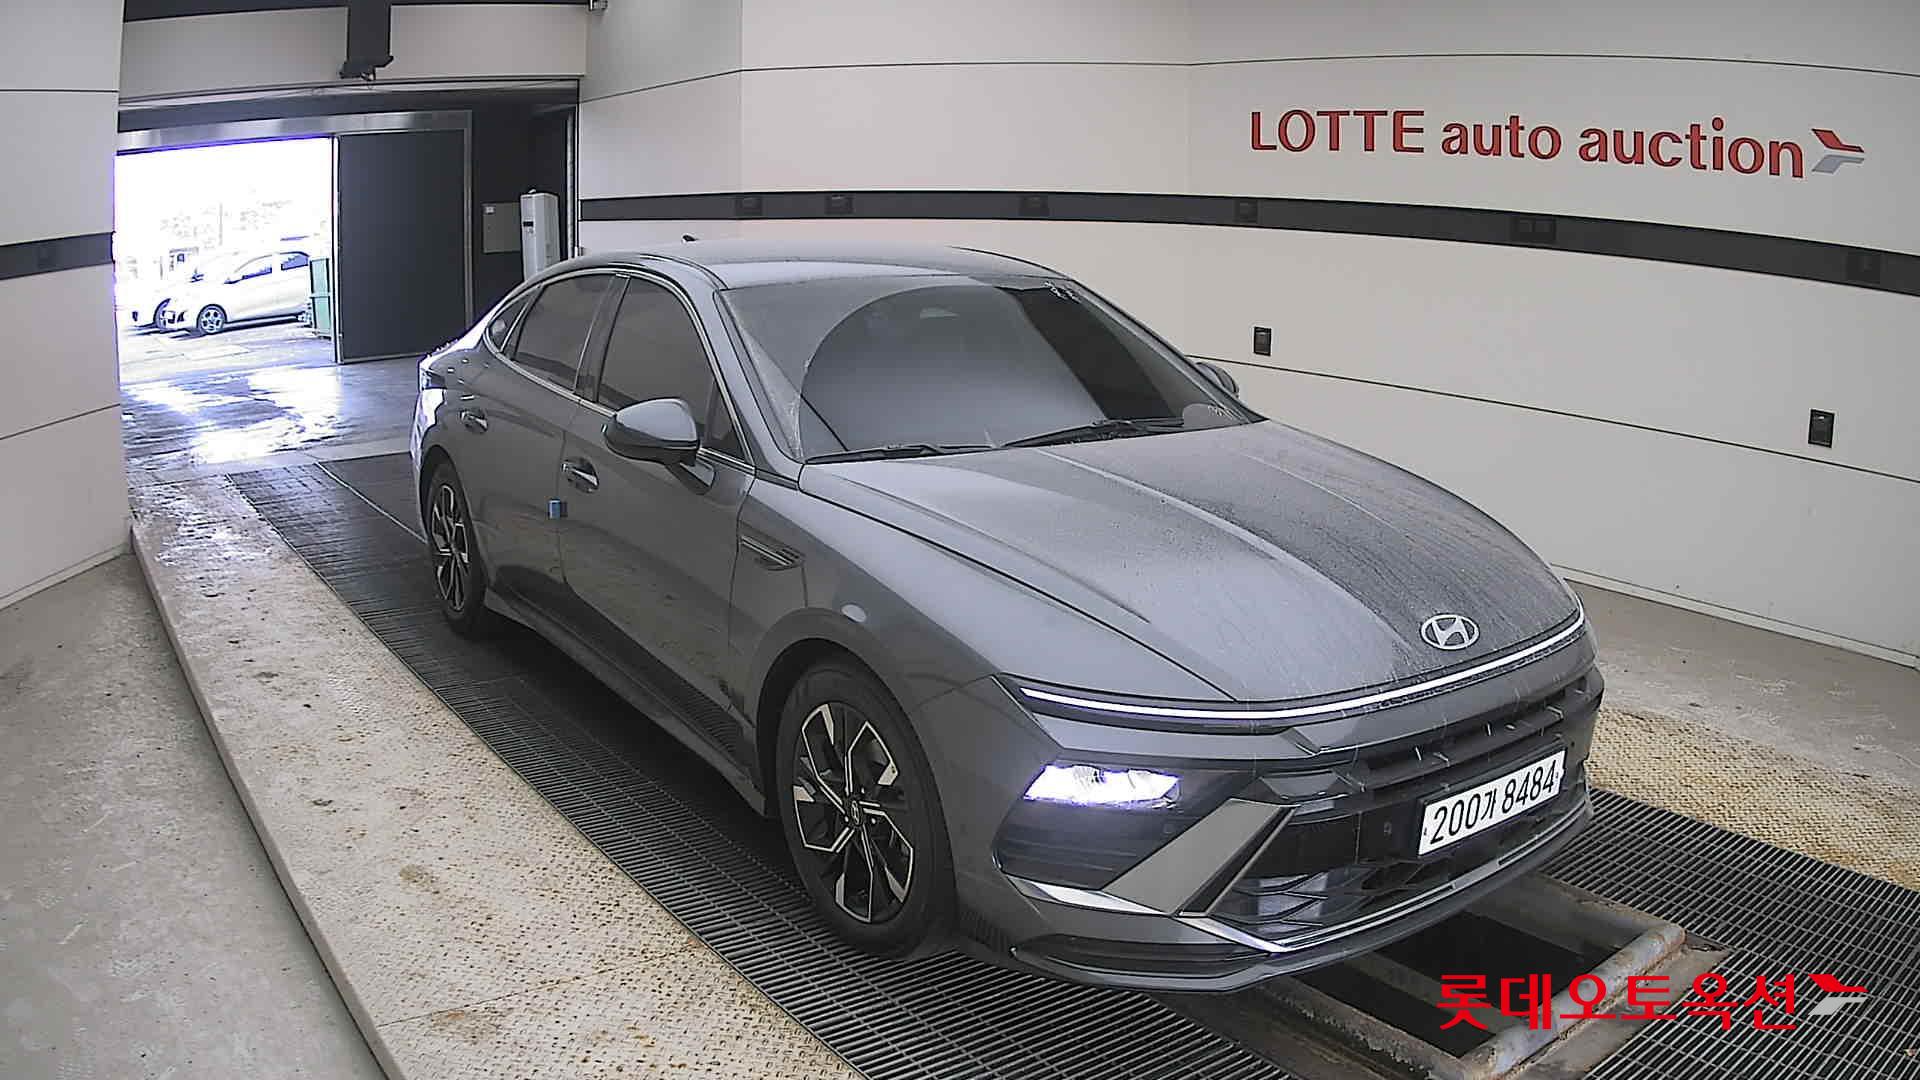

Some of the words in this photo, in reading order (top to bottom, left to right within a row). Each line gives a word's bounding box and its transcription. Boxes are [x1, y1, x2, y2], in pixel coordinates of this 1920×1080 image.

[1250, 109, 1426, 154] LOTTE
[1440, 115, 1563, 161] auto
[1576, 116, 1806, 179] auction
[1429, 787, 1499, 846] 200가
[1500, 758, 1558, 815] 8484
